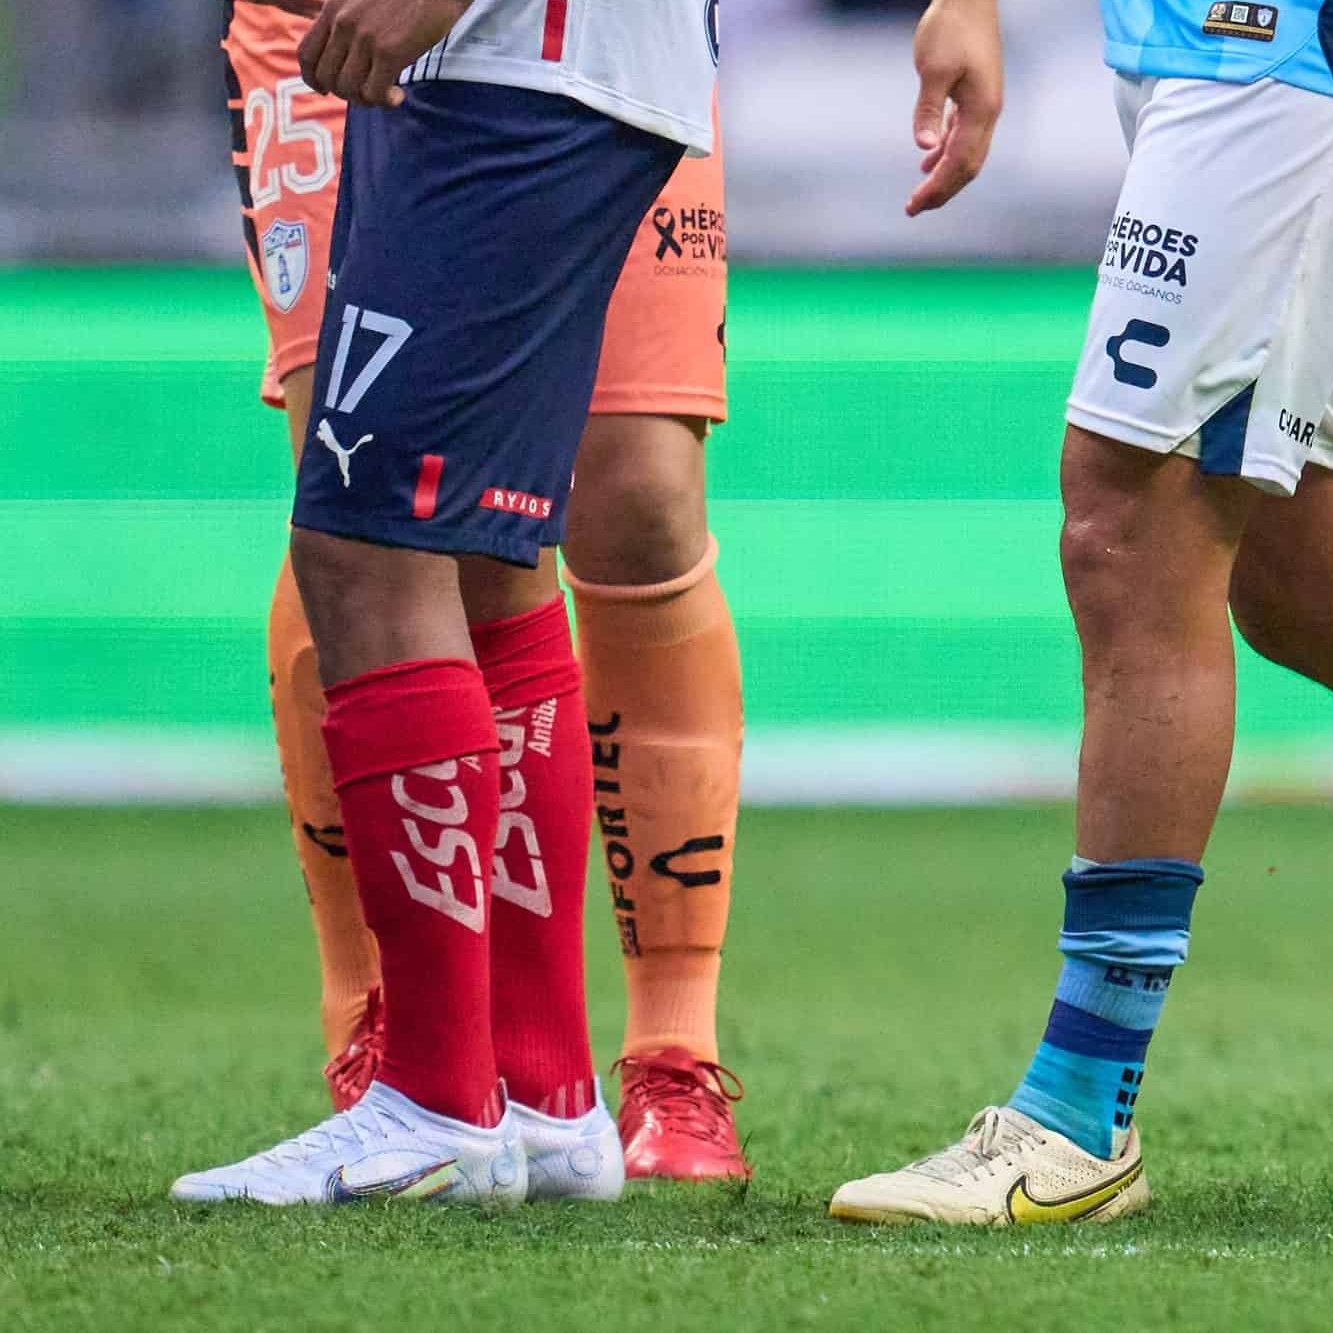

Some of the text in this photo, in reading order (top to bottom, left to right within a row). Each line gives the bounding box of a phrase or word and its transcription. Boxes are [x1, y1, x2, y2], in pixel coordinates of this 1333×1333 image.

[244, 75, 336, 210] 25
[1112, 211, 1199, 257] HÉROES
[1120, 243, 1187, 287] VIDA
[325, 303, 414, 414] 17
[1279, 408, 1315, 448] CHAR
